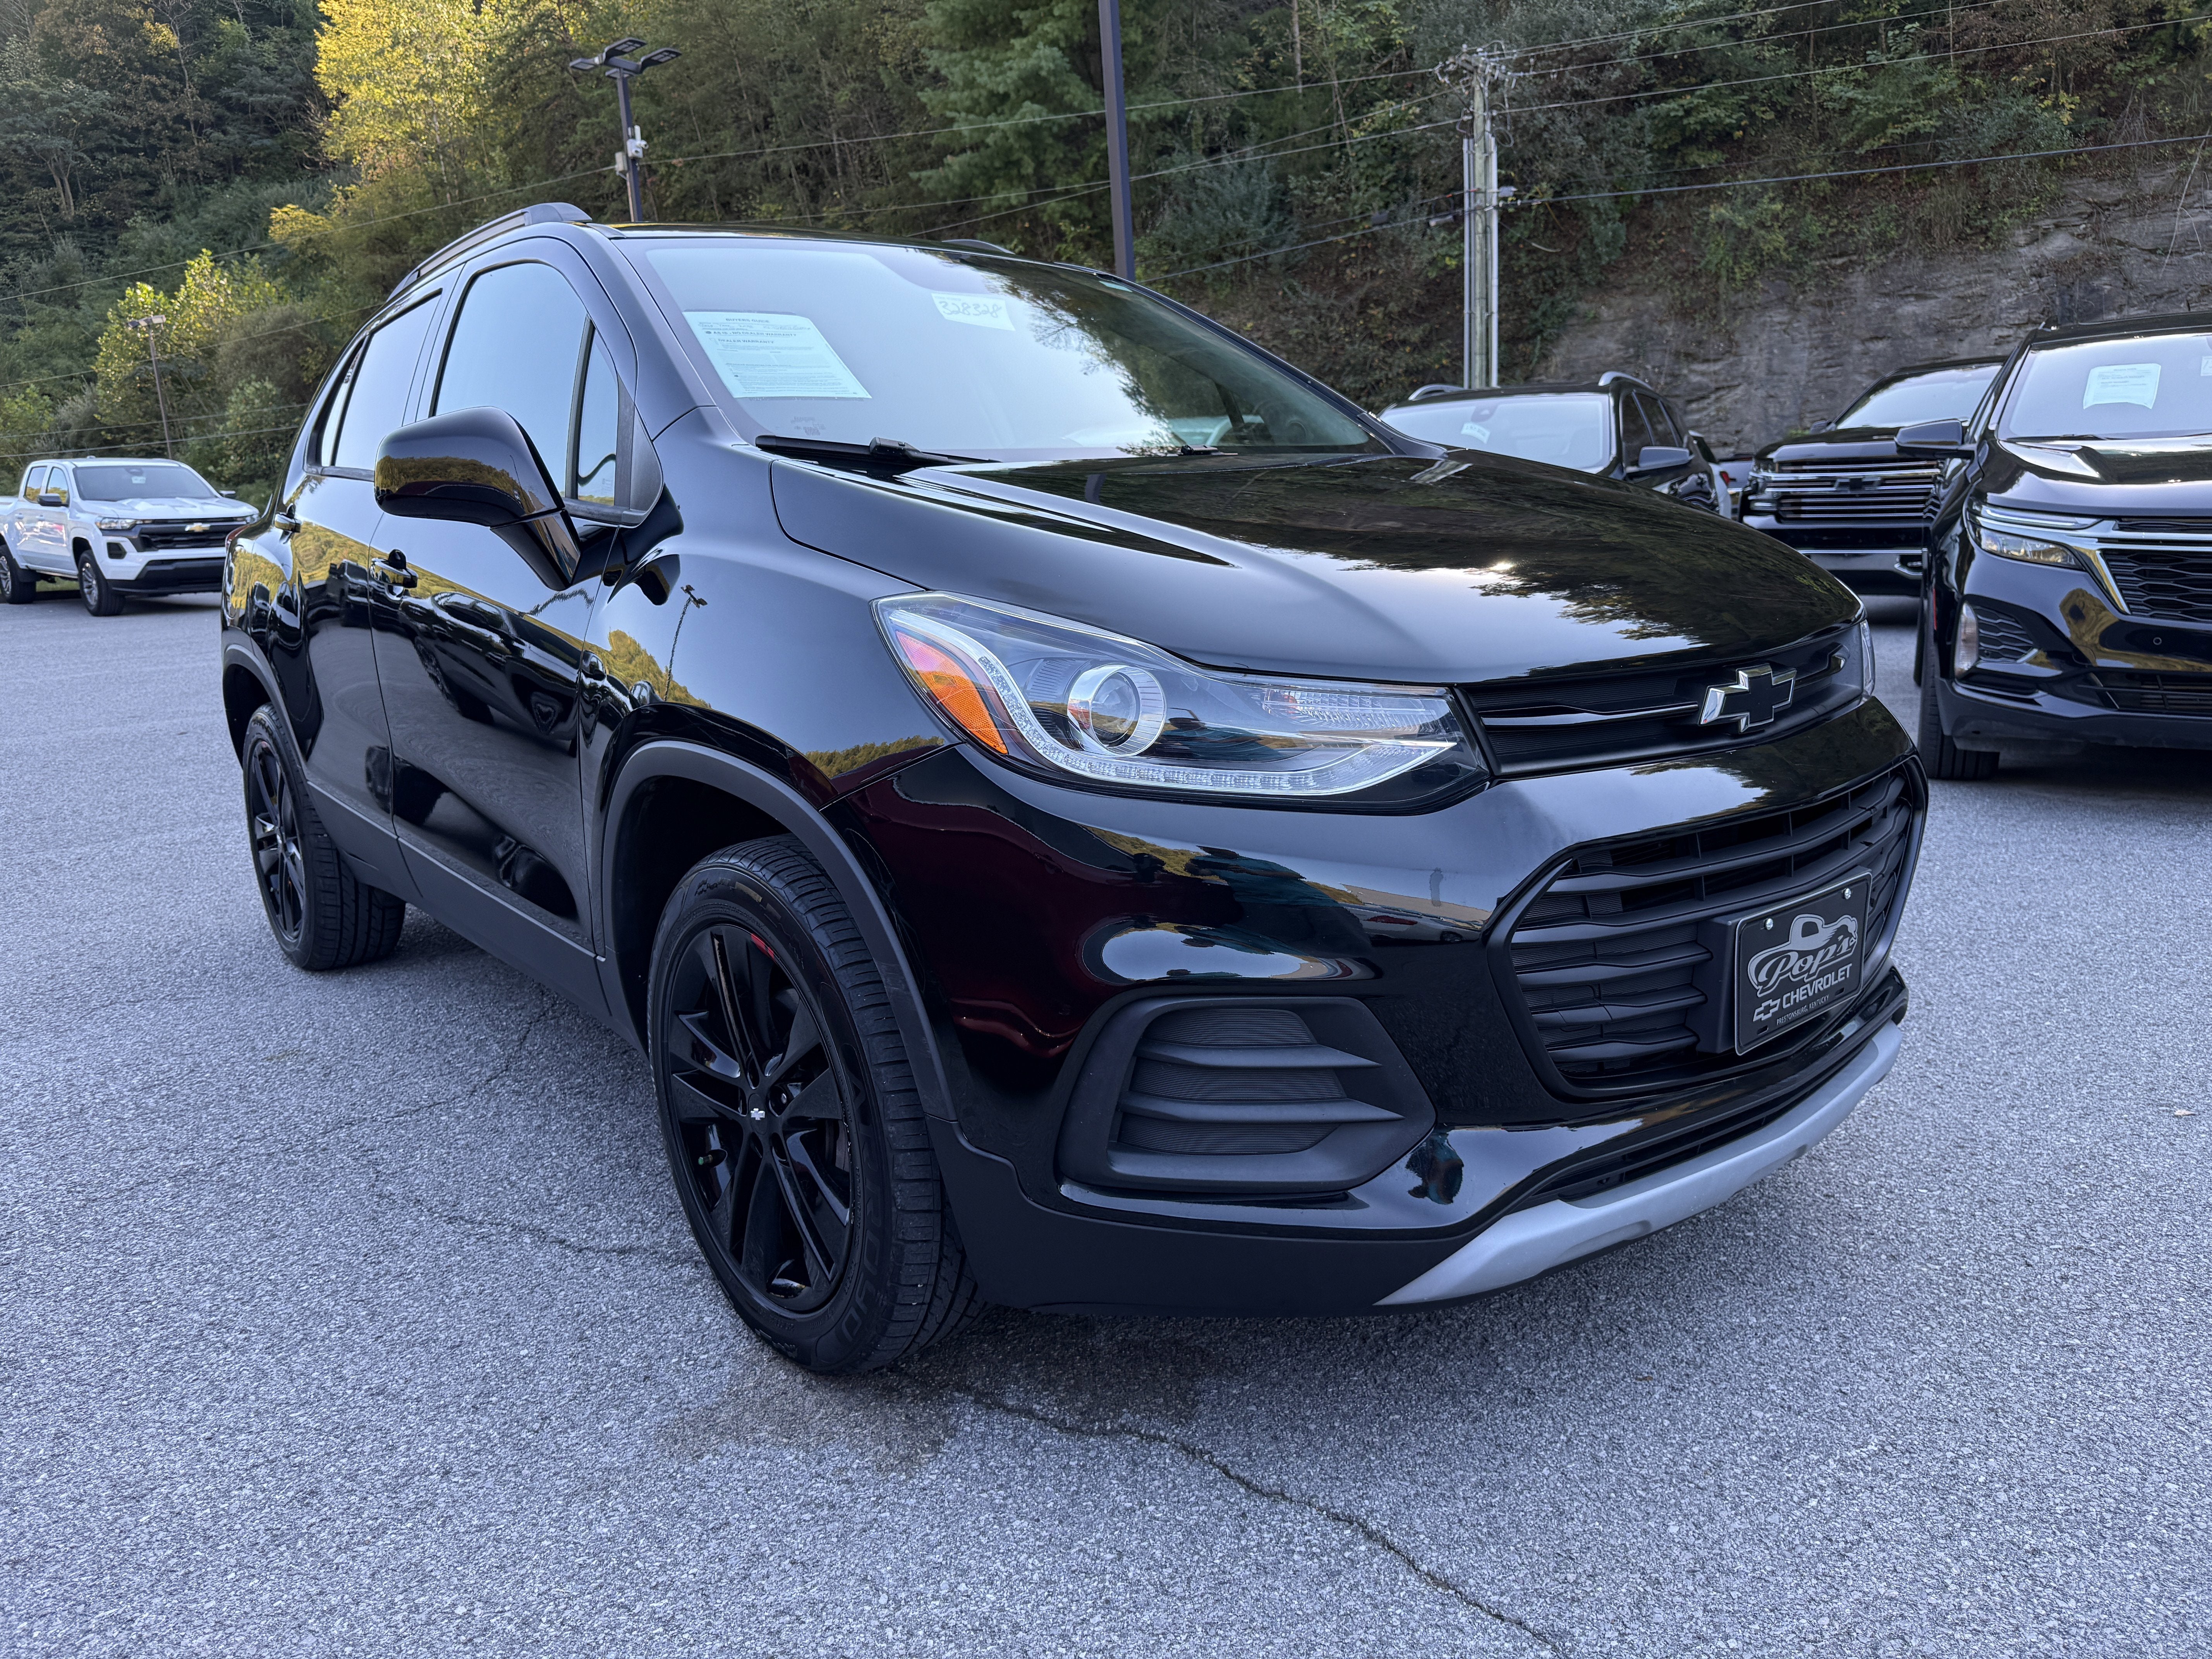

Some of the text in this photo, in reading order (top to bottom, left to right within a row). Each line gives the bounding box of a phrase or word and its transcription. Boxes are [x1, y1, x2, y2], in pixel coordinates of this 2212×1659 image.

[1758, 935, 1851, 989] Pop's
[1783, 963, 1852, 1009] CHEVROLET
[1809, 994, 1829, 1009] KENTUCKY
